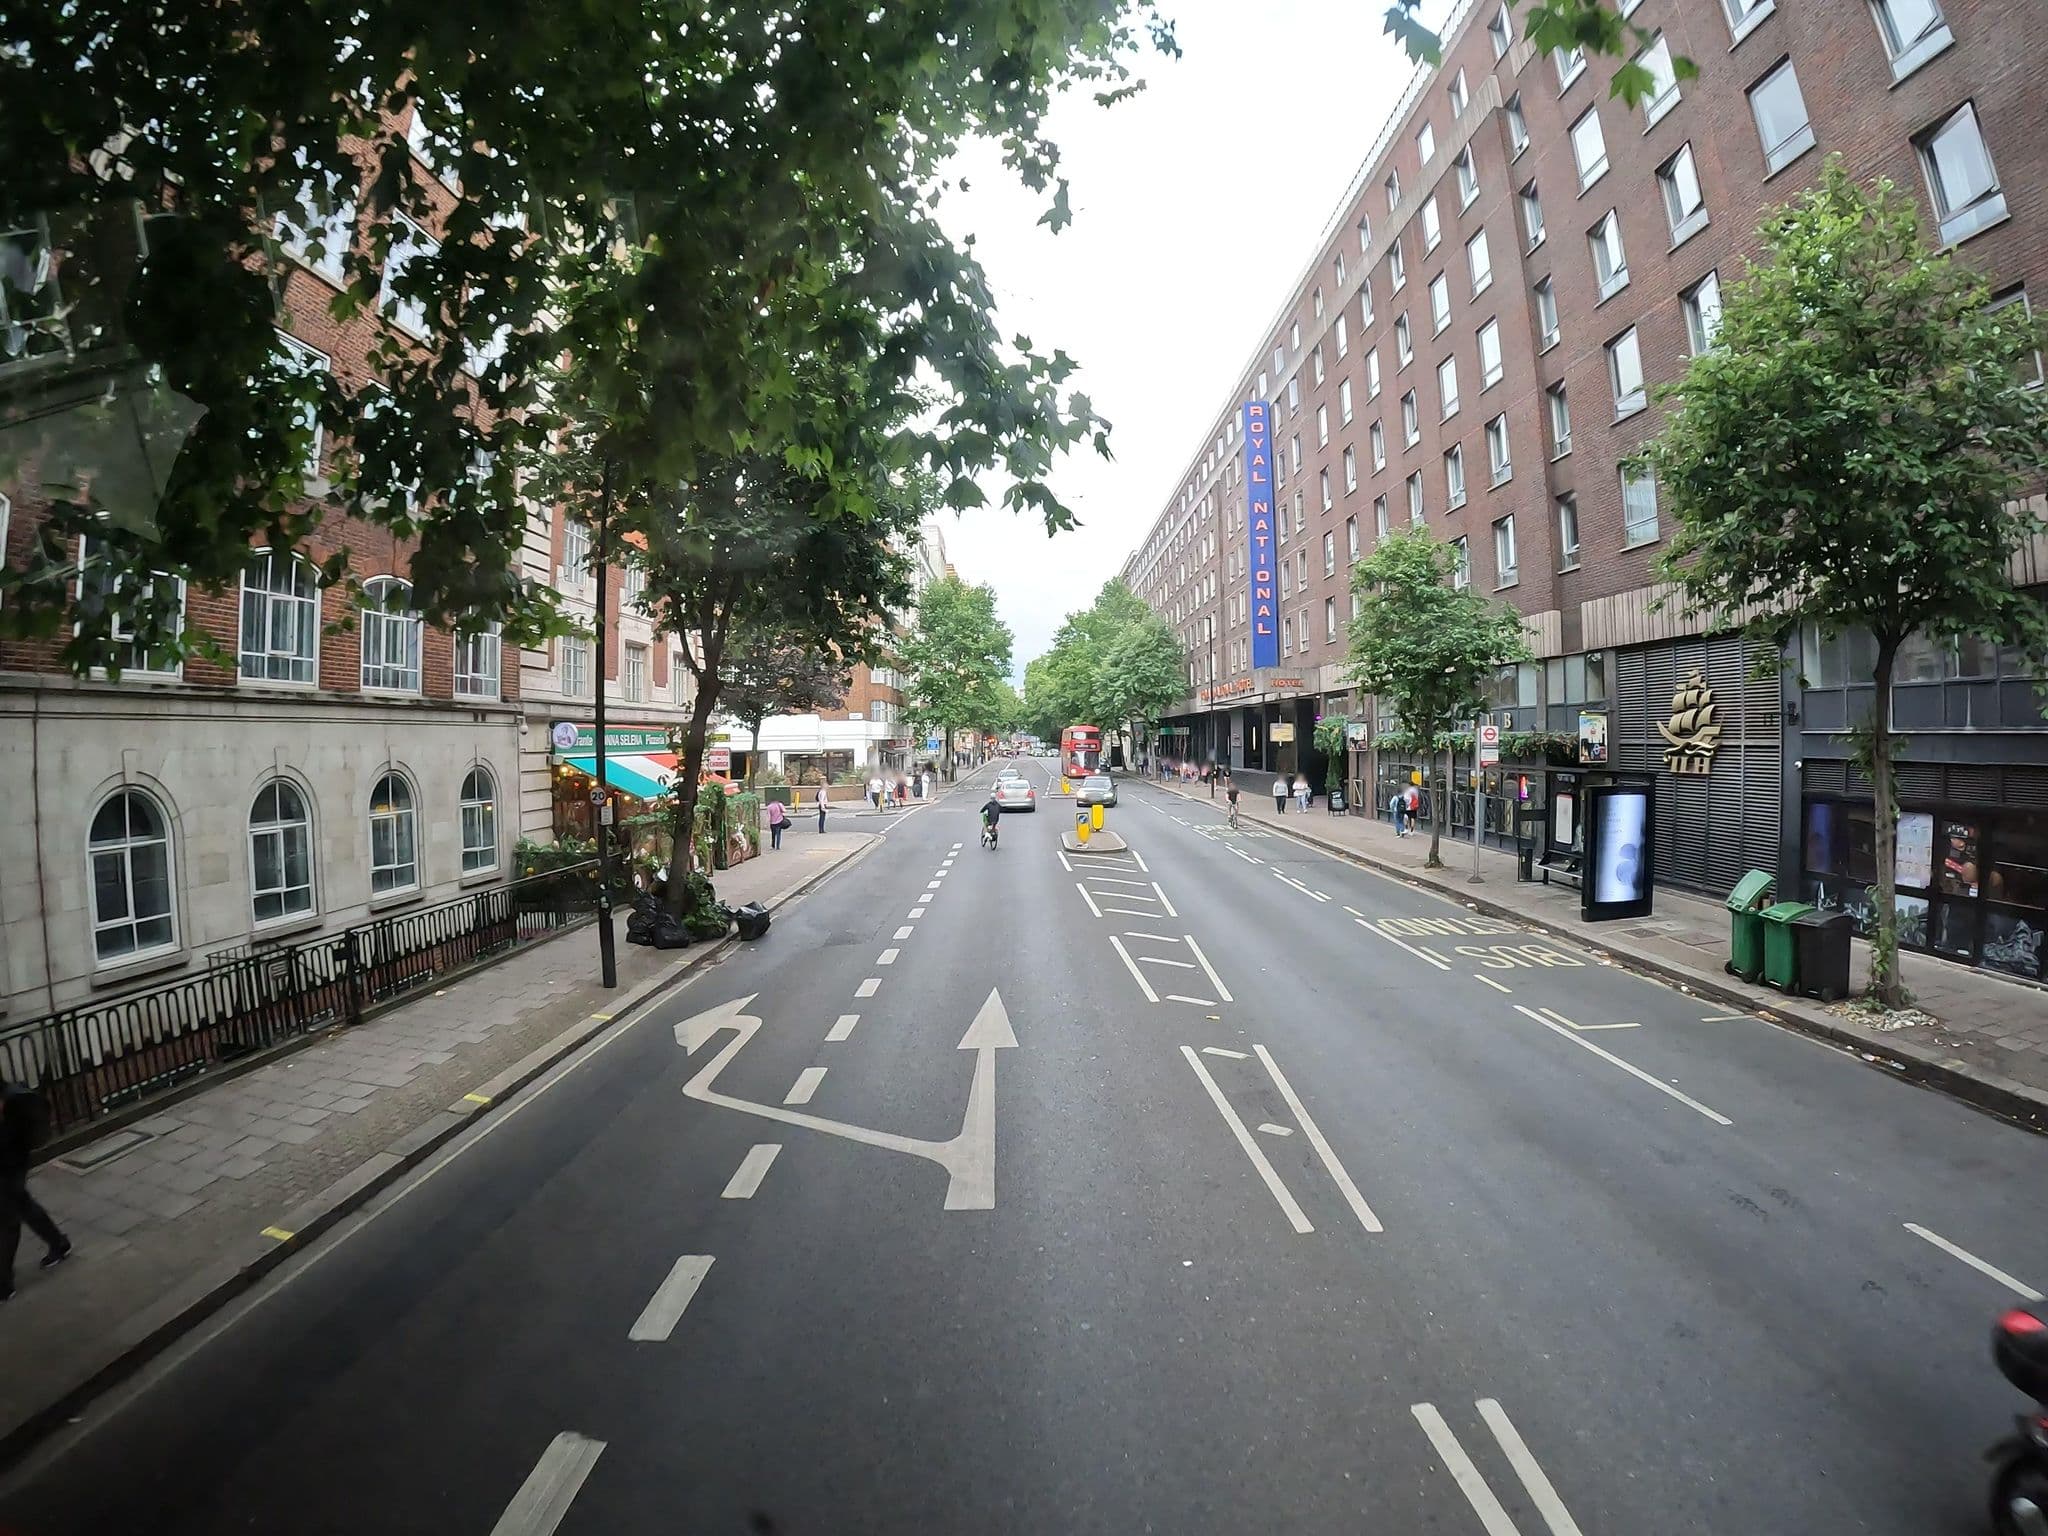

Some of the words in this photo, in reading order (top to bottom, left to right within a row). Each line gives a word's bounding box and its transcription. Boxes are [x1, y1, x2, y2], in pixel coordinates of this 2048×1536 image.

[1250, 405, 1266, 482] ROYAL
[1253, 501, 1271, 635] NATIONAL
[1271, 679, 1304, 688] HOTEL
[592, 791, 605, 801] 20
[1376, 917, 1522, 937] STAND
[1454, 944, 1586, 969] BUS
